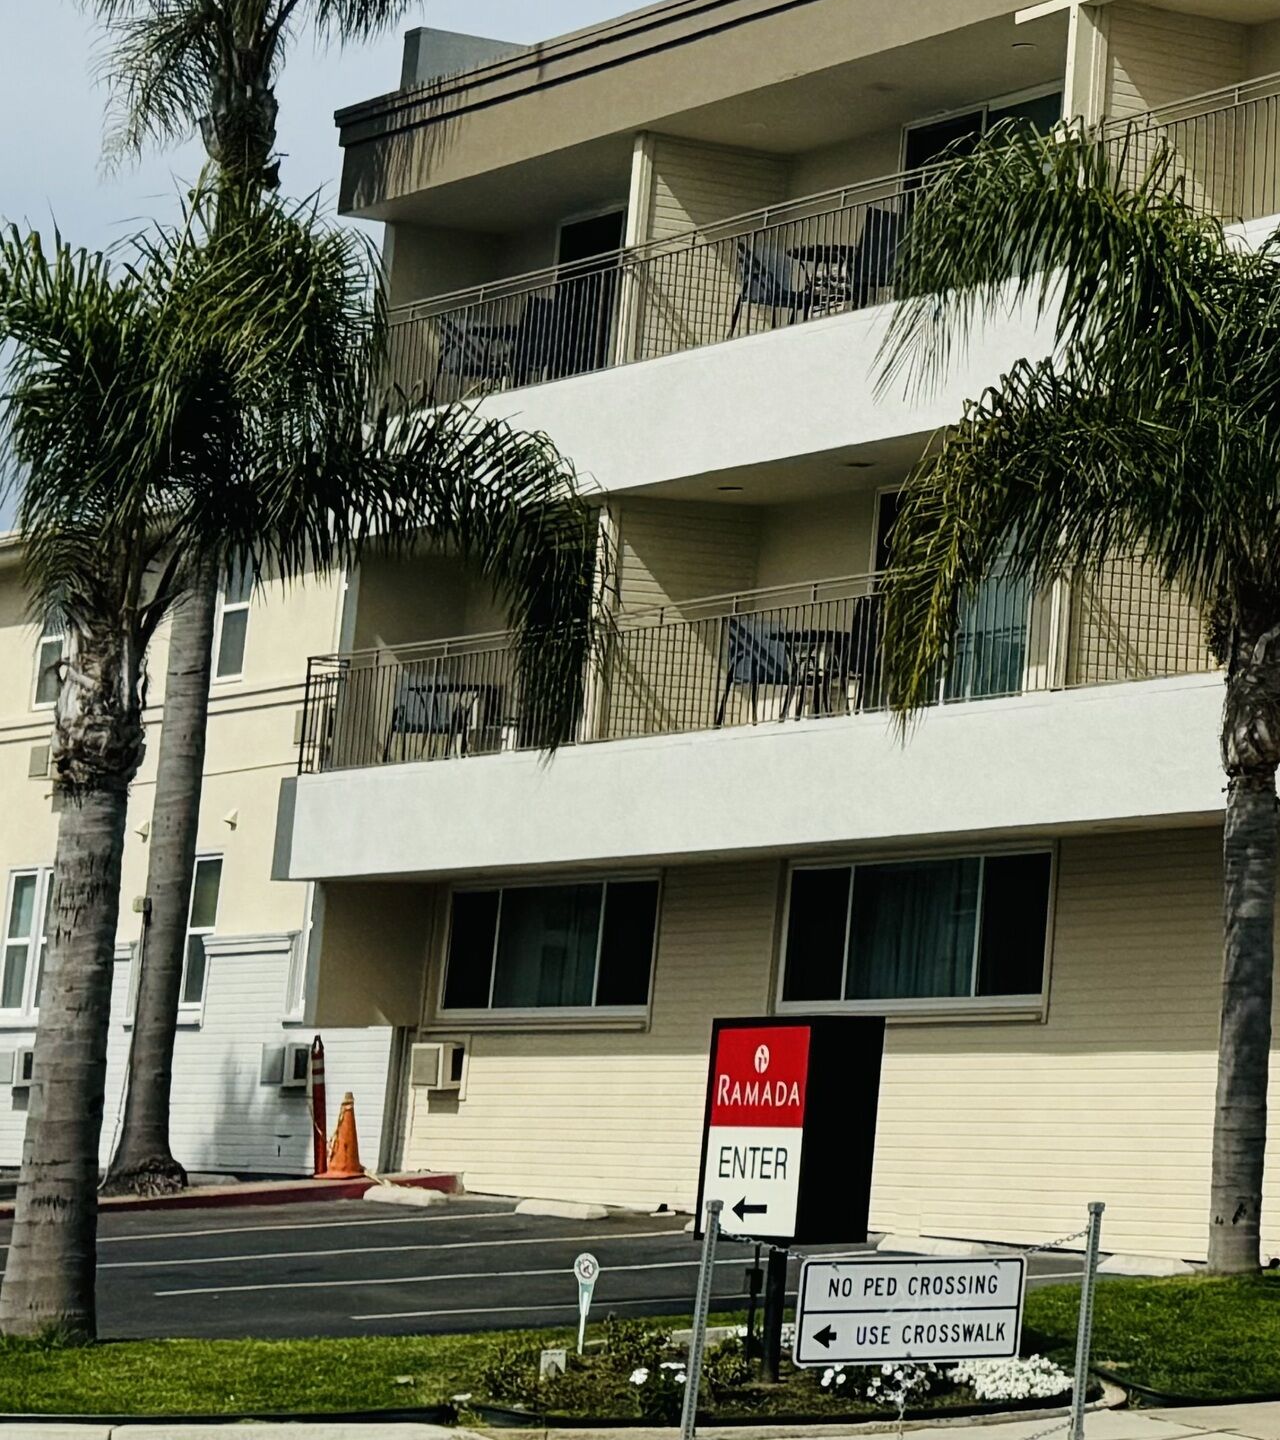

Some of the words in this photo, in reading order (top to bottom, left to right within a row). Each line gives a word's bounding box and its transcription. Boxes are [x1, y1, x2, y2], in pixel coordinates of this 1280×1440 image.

[717, 1074, 800, 1107] RAMADA
[718, 1146, 788, 1180] ENTER
[828, 1277, 852, 1298] NO
[864, 1277, 897, 1297] PED
[908, 1274, 999, 1296] CROSSING
[856, 1325, 891, 1345] USE
[902, 1322, 1006, 1344] CROSSWALK
